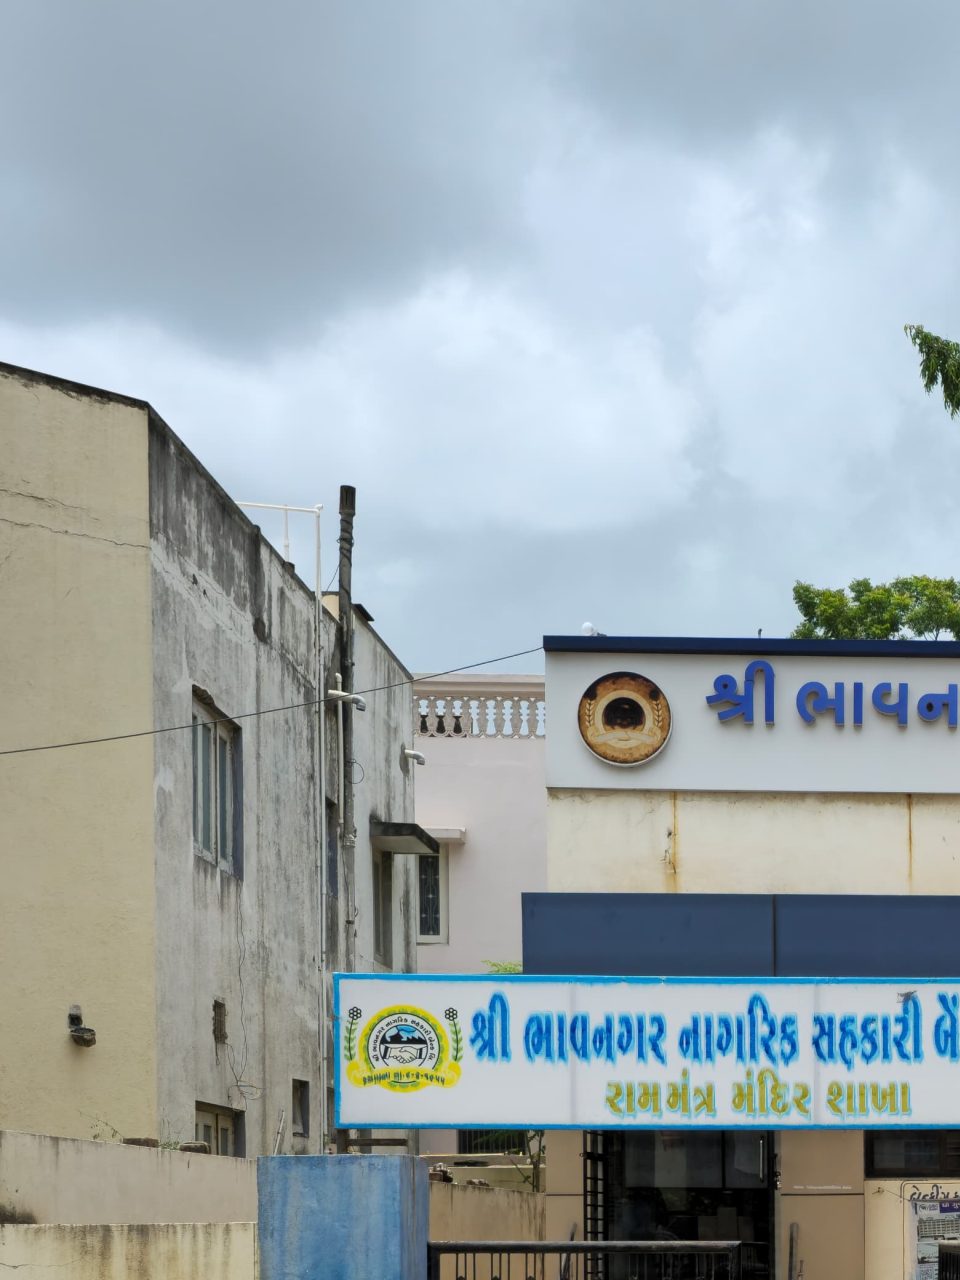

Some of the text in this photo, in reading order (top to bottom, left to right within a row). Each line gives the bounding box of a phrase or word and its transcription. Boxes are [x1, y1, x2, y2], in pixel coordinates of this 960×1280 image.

[705, 660, 775, 726] શ્રી
[469, 991, 512, 1063] શ્રી
[523, 1011, 668, 1067] ભાવનગર
[677, 992, 800, 1068] નાગરિક
[811, 992, 925, 1070] સહકારી
[732, 1067, 811, 1117] મંદિર
[826, 1081, 912, 1117] શાખા
